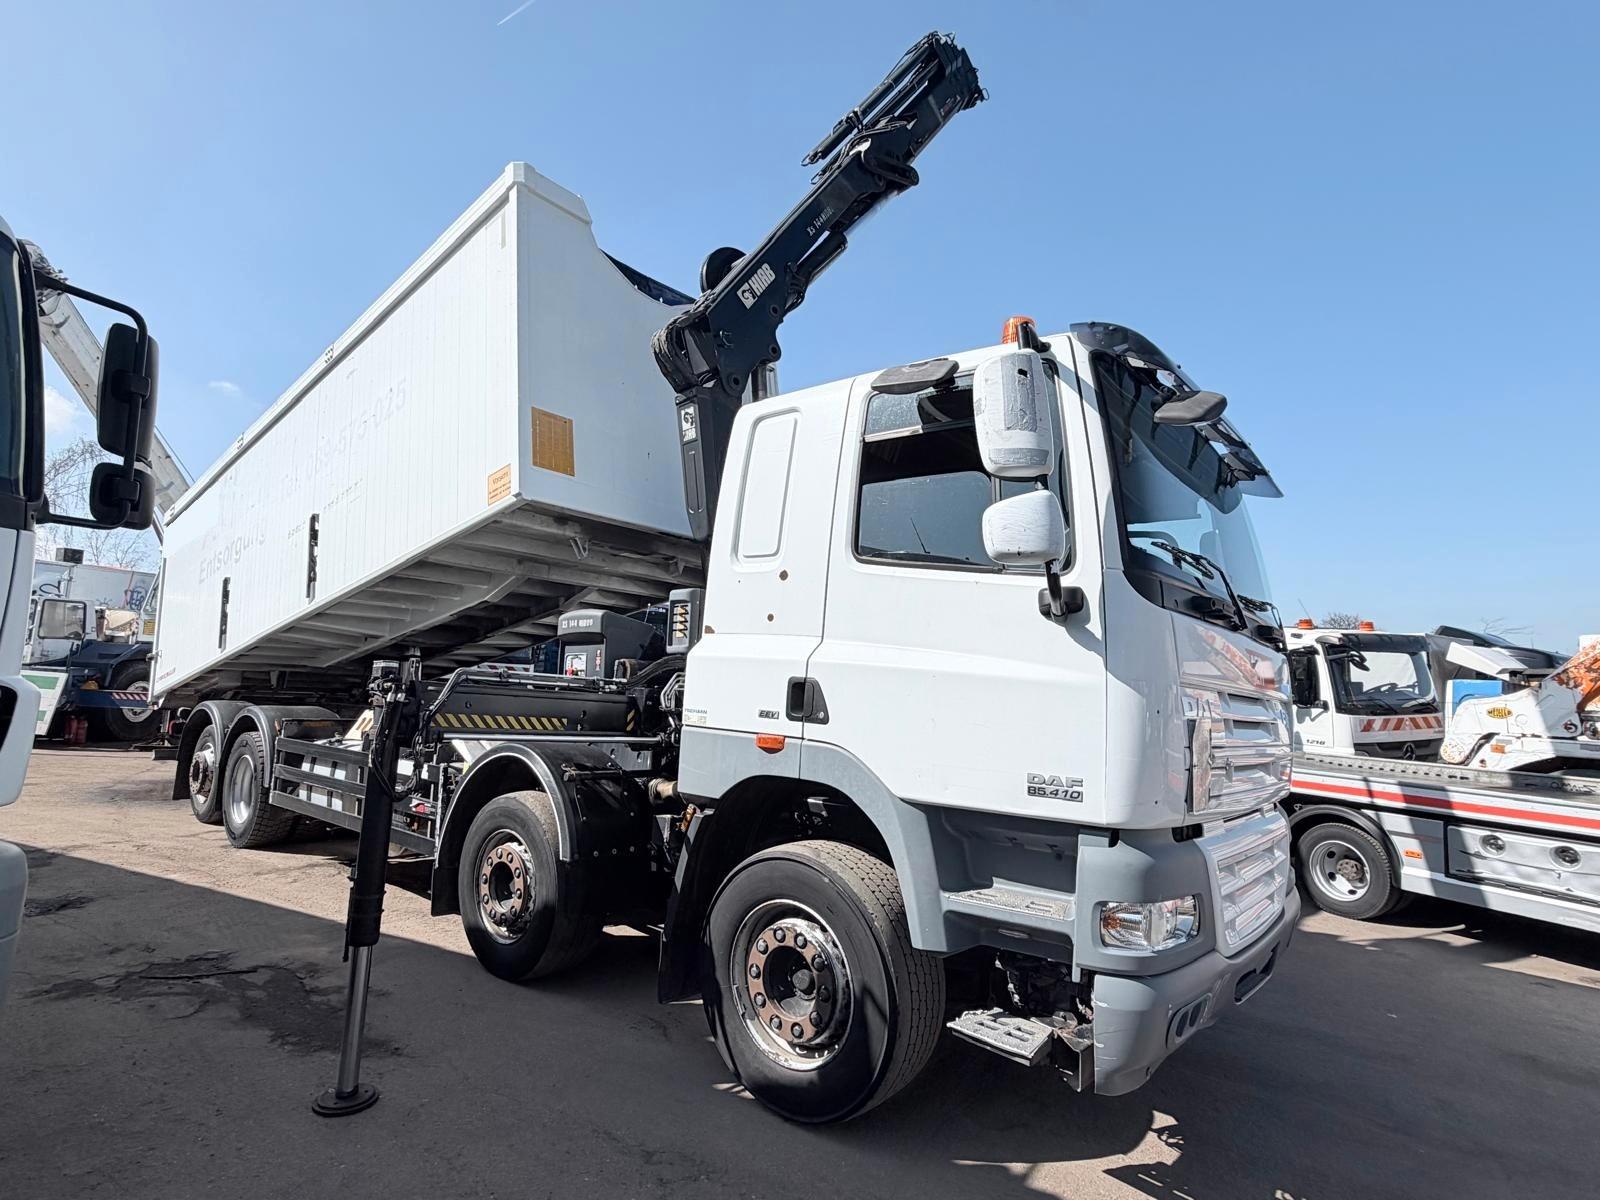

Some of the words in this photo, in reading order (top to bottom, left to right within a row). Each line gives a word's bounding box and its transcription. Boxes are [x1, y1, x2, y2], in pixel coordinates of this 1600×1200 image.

[748, 262, 776, 296] HIAB
[1027, 772, 1084, 788] DAF
[1027, 786, 1083, 800] 85.410
